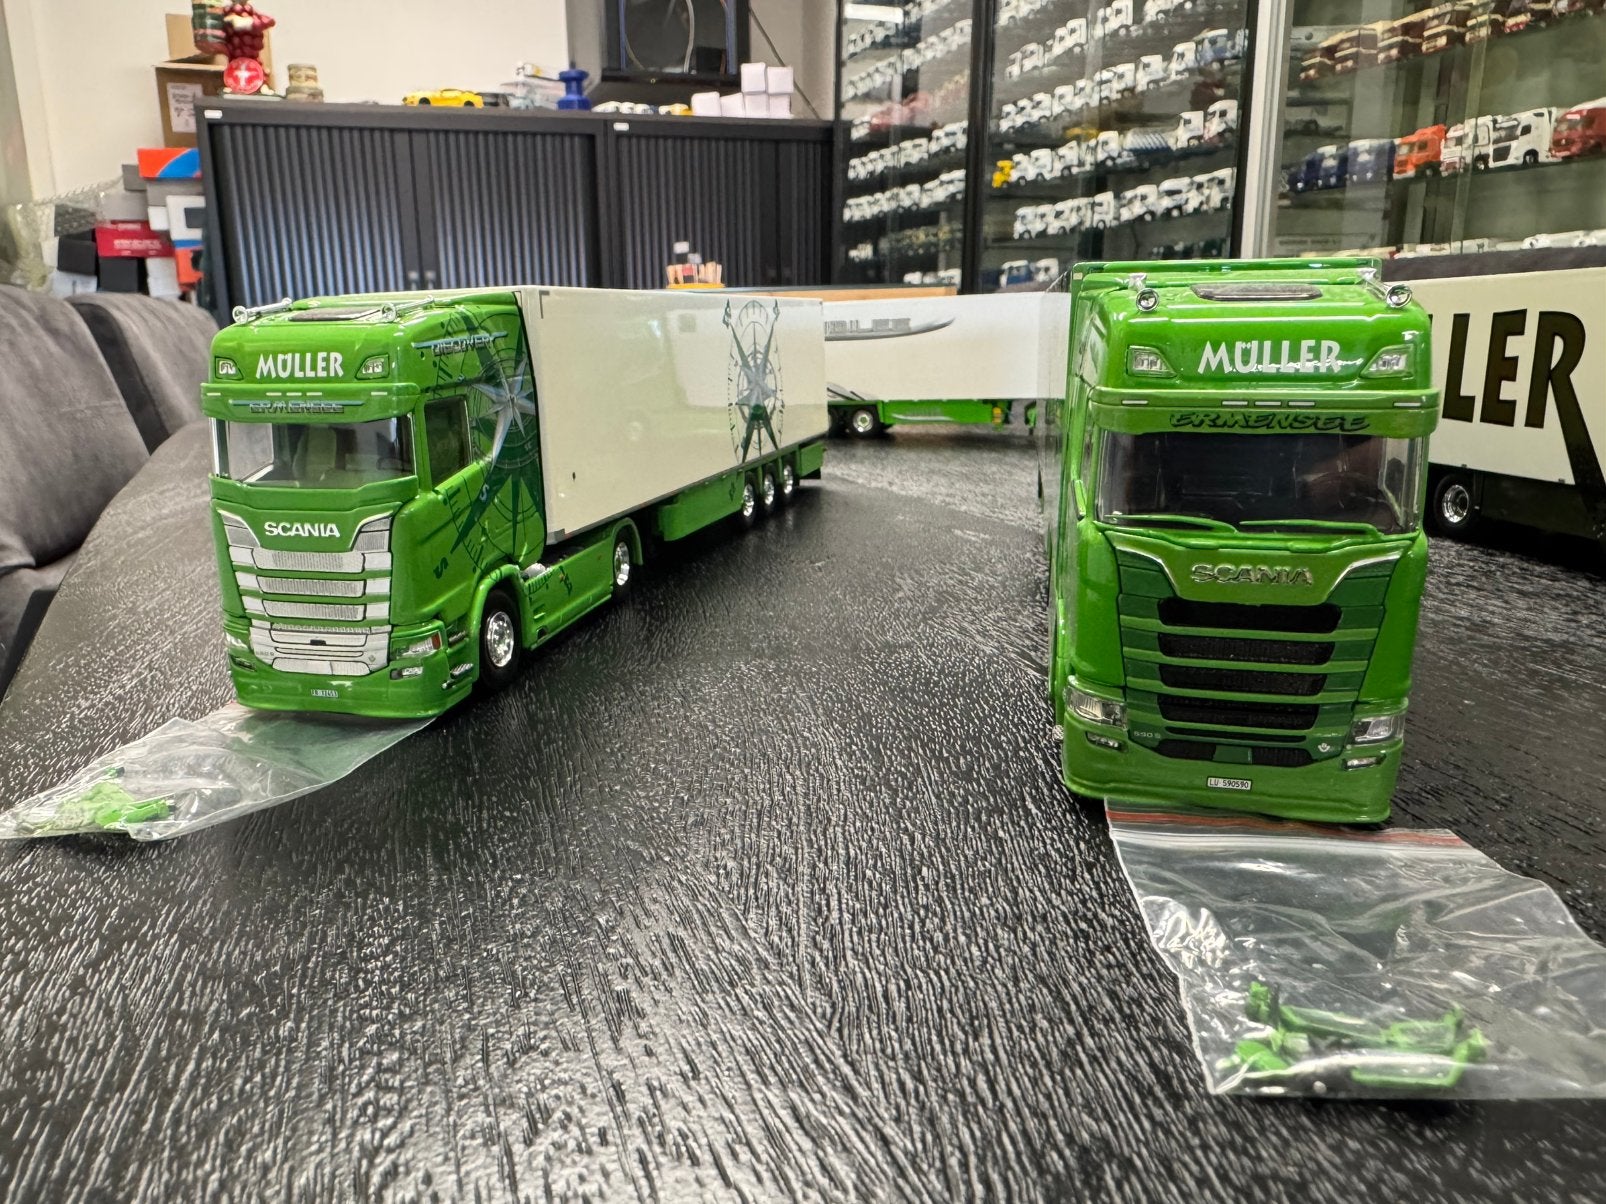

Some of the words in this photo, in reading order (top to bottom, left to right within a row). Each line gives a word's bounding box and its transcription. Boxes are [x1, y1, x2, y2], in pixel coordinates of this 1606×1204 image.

[255, 351, 344, 379] MÜLLER
[1197, 339, 1342, 375] MÜLLER
[1169, 412, 1370, 433] ERMENSEE
[263, 521, 340, 538] SCANIA
[1190, 564, 1313, 586] SCANIA
[1209, 778, 1219, 786] LU
[1222, 779, 1249, 788] 590590
